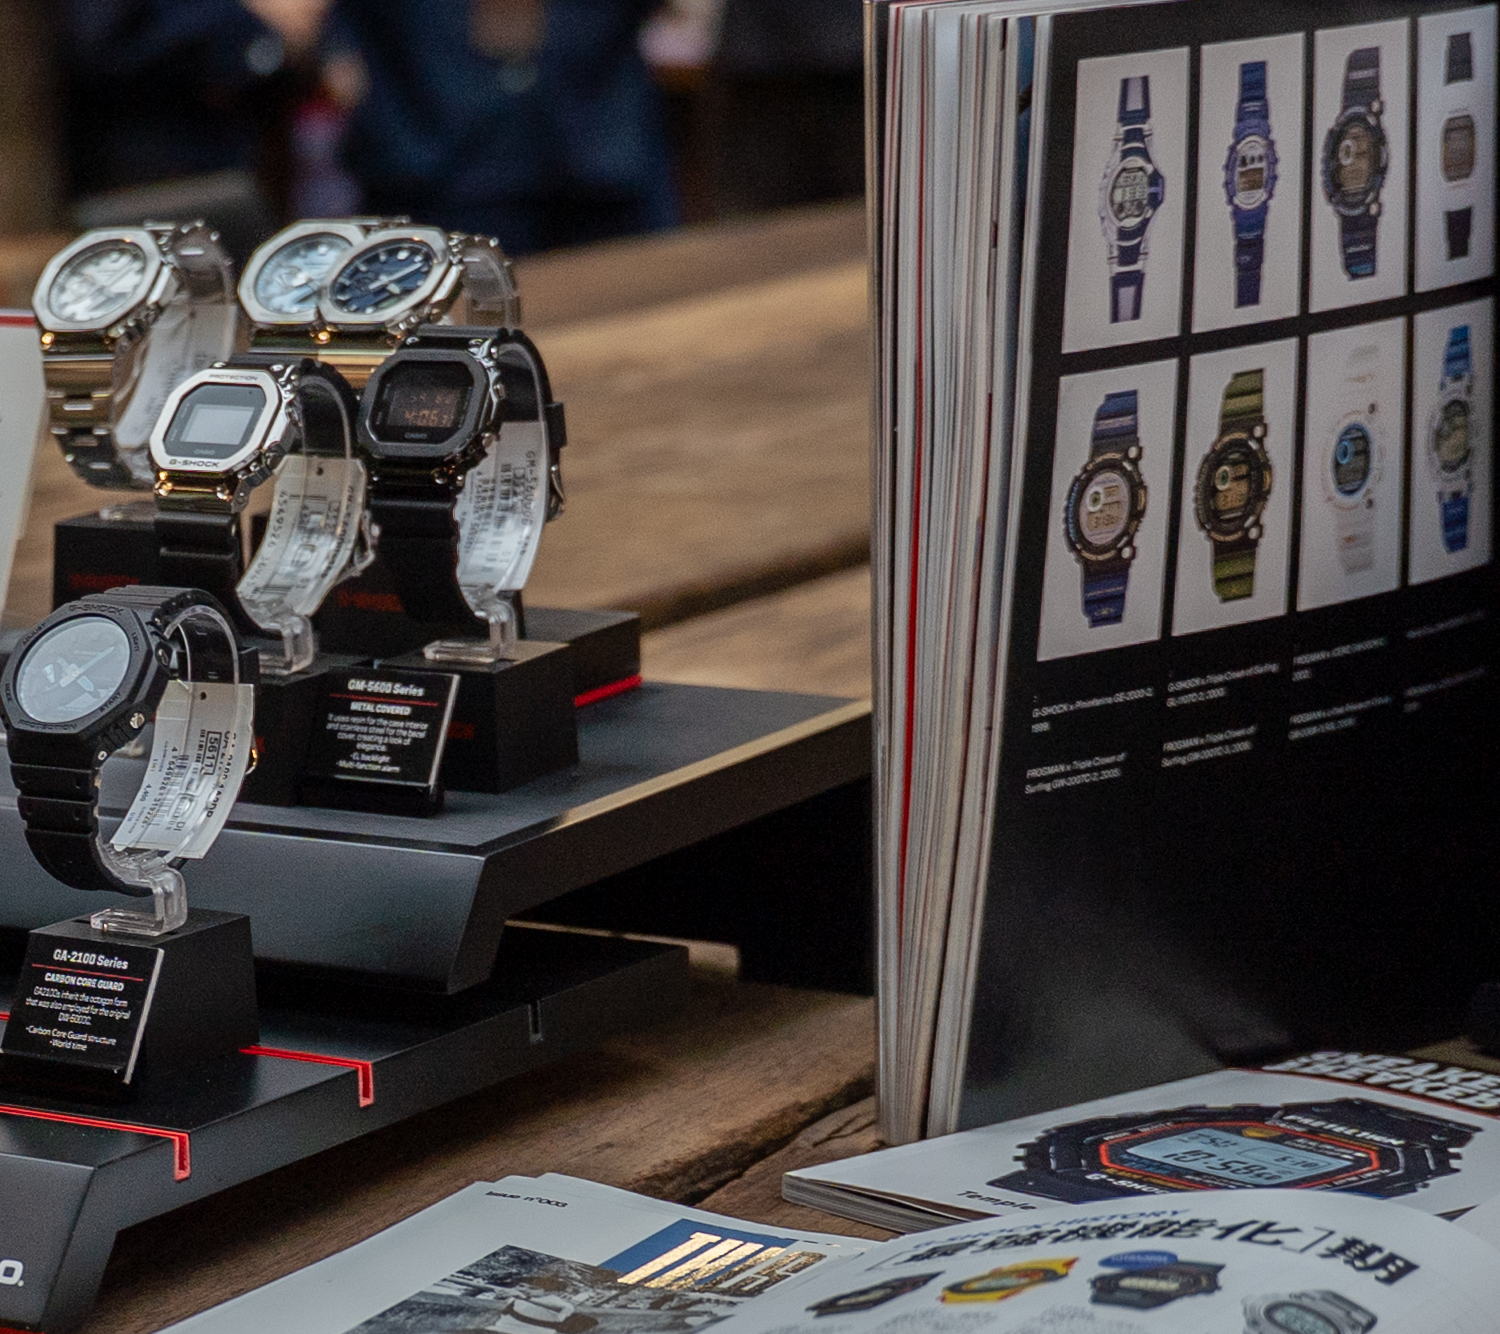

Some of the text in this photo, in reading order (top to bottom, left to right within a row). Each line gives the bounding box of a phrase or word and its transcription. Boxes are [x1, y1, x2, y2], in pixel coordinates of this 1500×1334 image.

[208, 373, 258, 382] PROTECTION
[169, 457, 220, 468] G-SHOCK
[68, 603, 124, 616] G-SHOCK
[393, 683, 425, 697] Series
[53, 948, 129, 970] GA-2100 Series
[44, 972, 125, 992] CARBON CORE GUARD
[484, 1189, 521, 1201] Issue
[956, 1189, 1038, 1211] Temple
[1056, 1208, 1190, 1227] HISTORY
